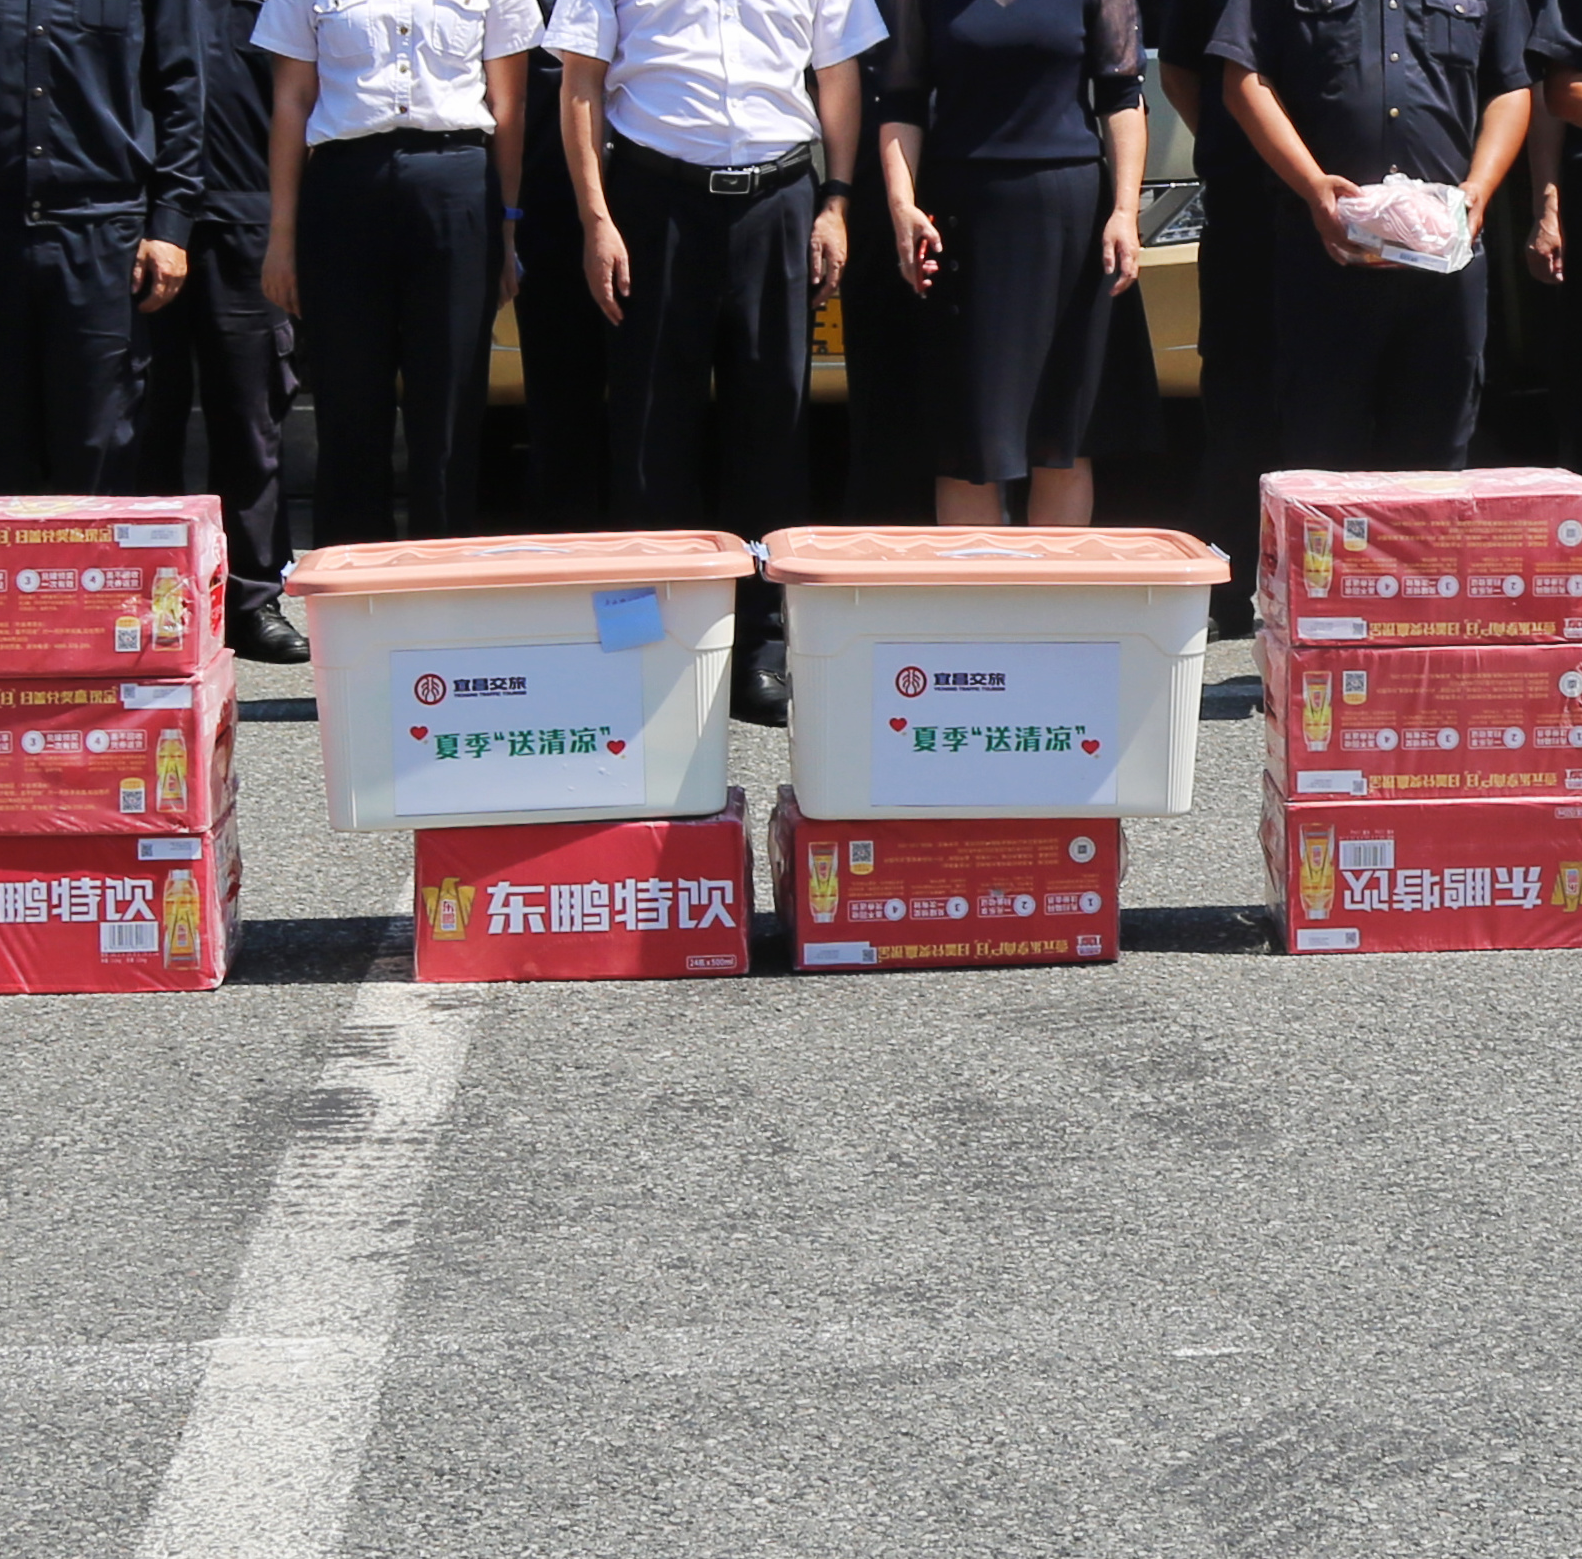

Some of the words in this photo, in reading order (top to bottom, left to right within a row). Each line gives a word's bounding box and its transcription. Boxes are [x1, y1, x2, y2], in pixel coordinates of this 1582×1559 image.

[453, 677, 527, 692] 宜昌交旅
[934, 672, 1006, 686] 宜昌交旅
[1343, 865, 1544, 912] 东鹏特饮
[486, 877, 737, 935] 东鹏特饮
